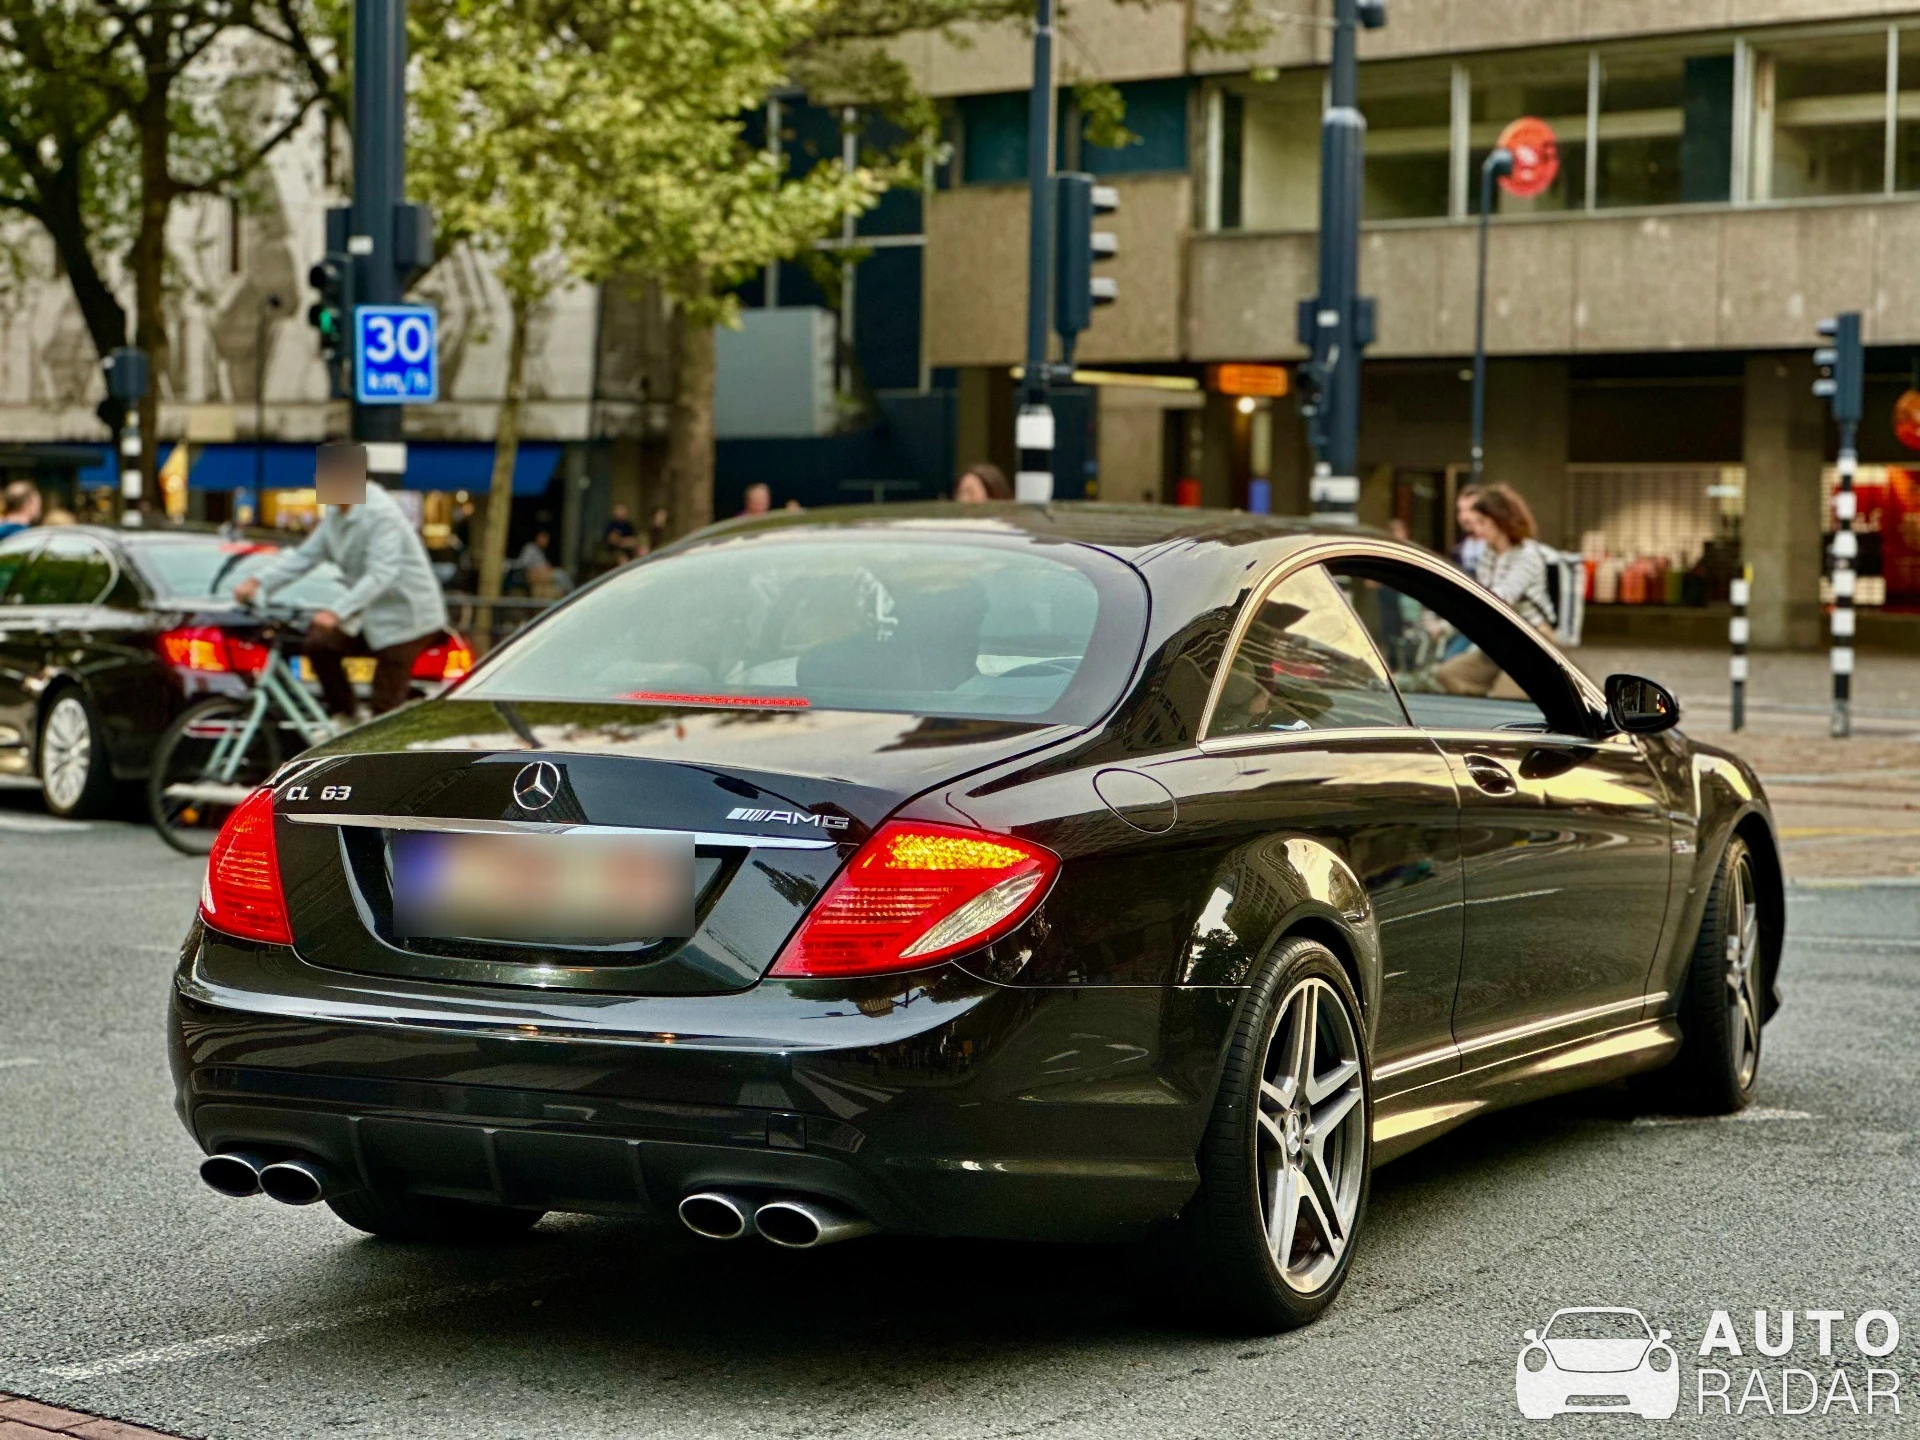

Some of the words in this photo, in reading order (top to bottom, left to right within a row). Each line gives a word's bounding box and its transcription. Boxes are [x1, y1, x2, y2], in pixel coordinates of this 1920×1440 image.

[366, 315, 429, 363] 30
[367, 370, 429, 394] km/h
[285, 786, 310, 801] CL
[320, 785, 352, 801] 63
[764, 810, 850, 830] AMG
